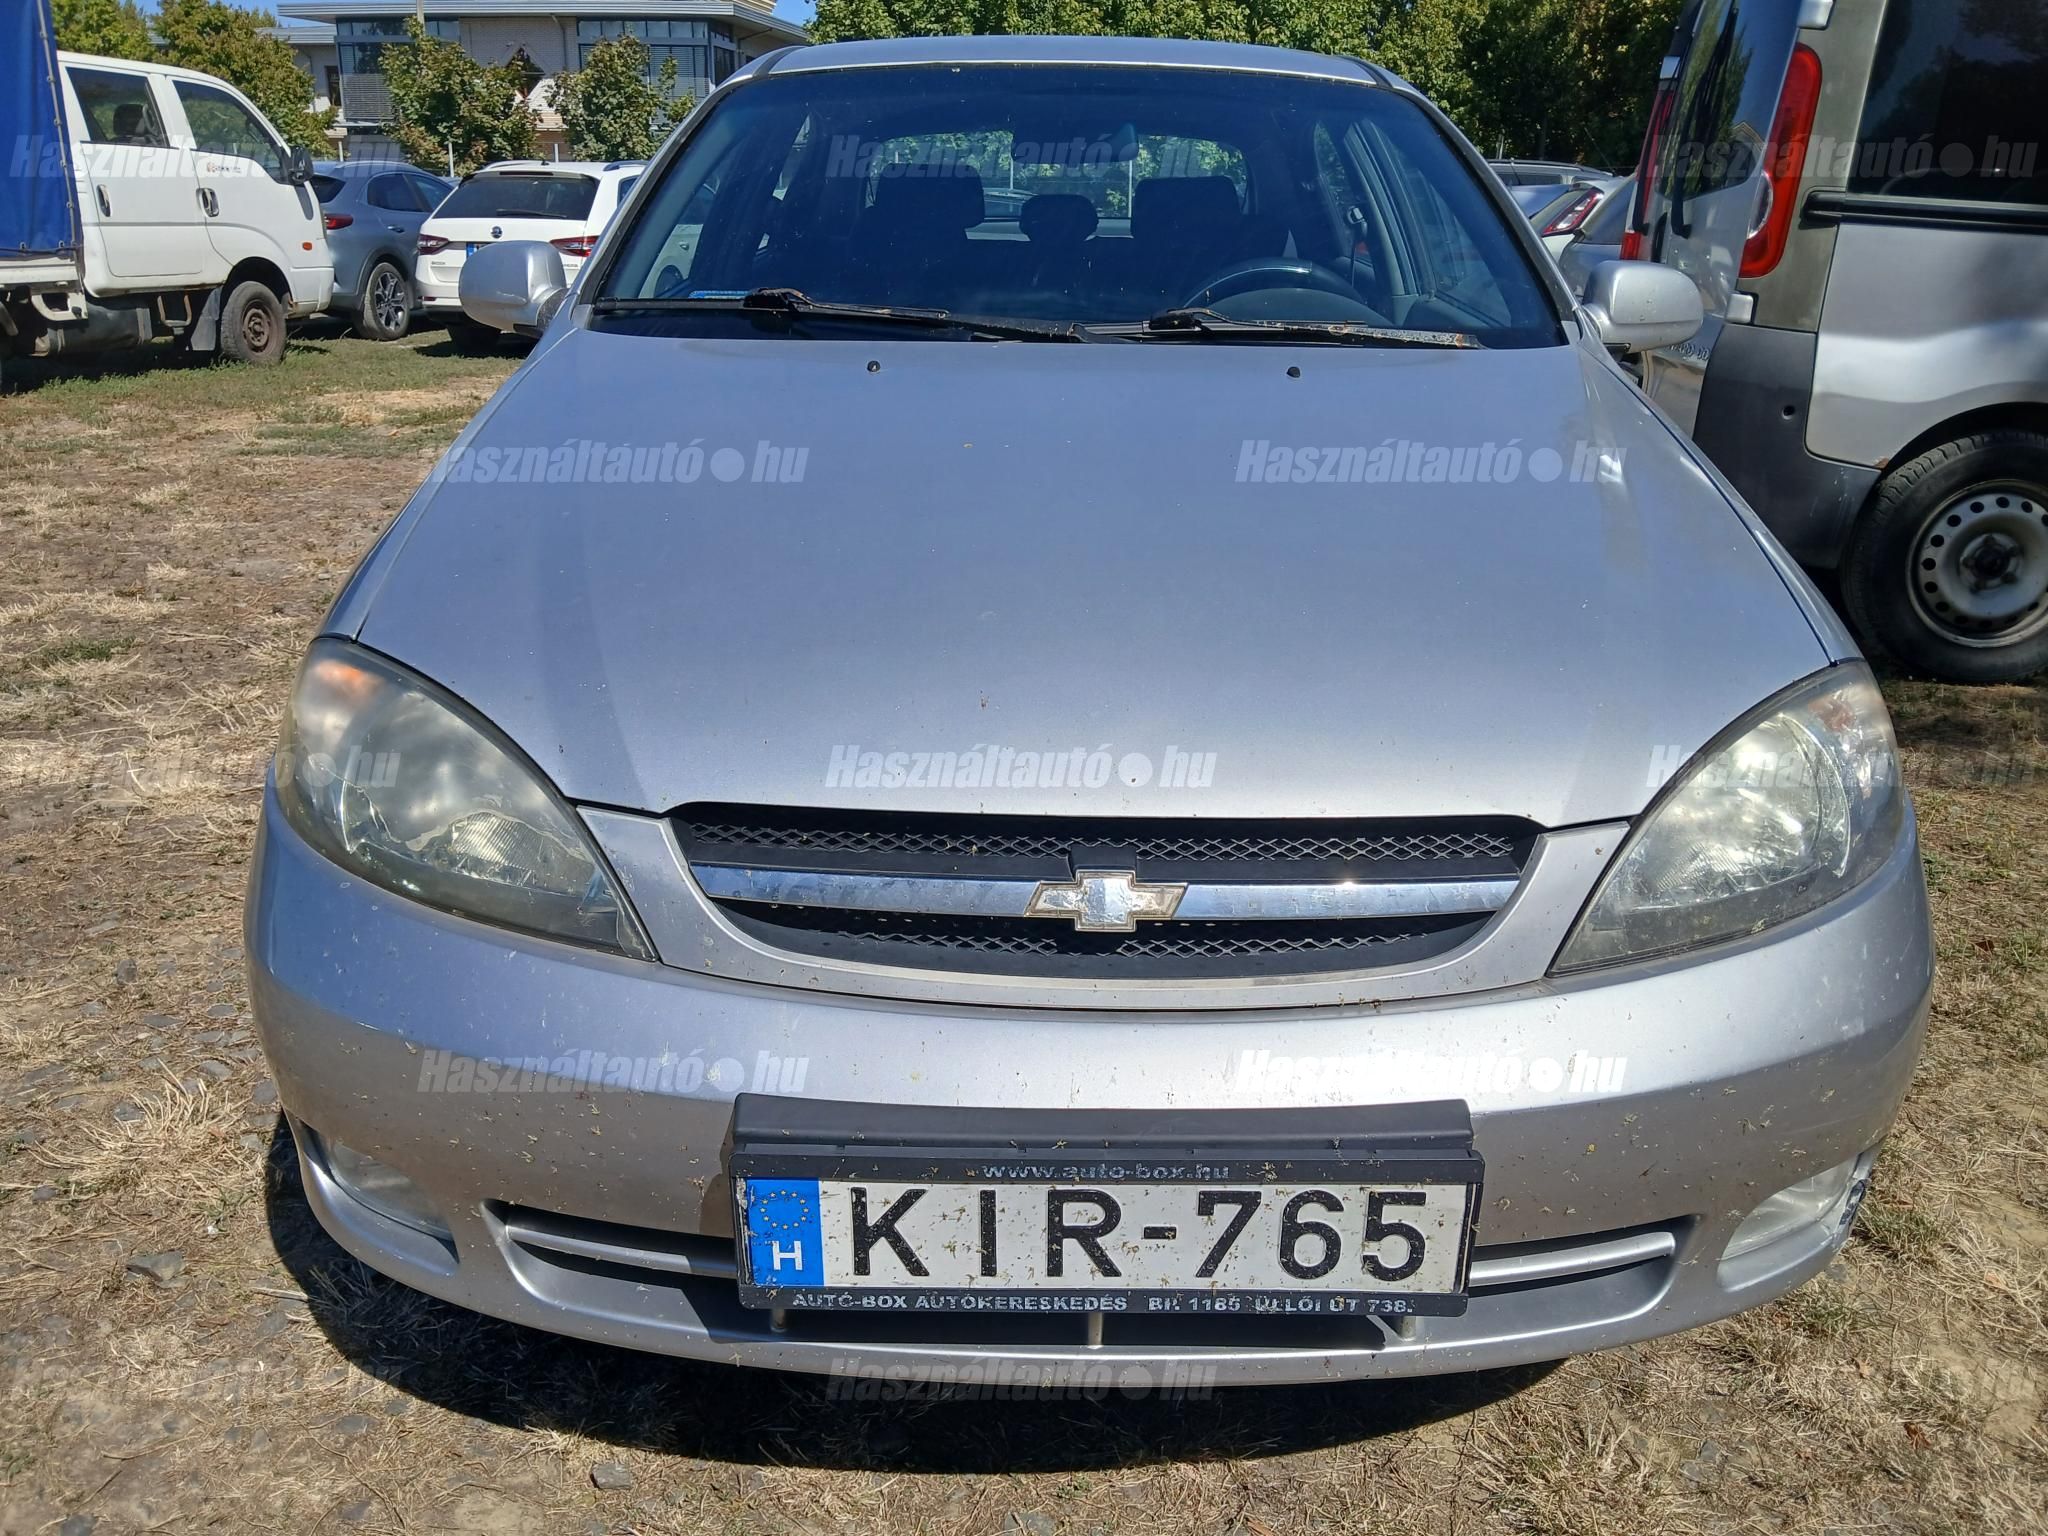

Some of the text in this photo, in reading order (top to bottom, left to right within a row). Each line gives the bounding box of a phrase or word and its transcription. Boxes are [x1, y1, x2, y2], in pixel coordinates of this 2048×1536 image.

[981, 1161, 1229, 1180] www.auto-box.hu
[851, 1187, 1428, 1281] KIR-765
[772, 1240, 803, 1271] H
